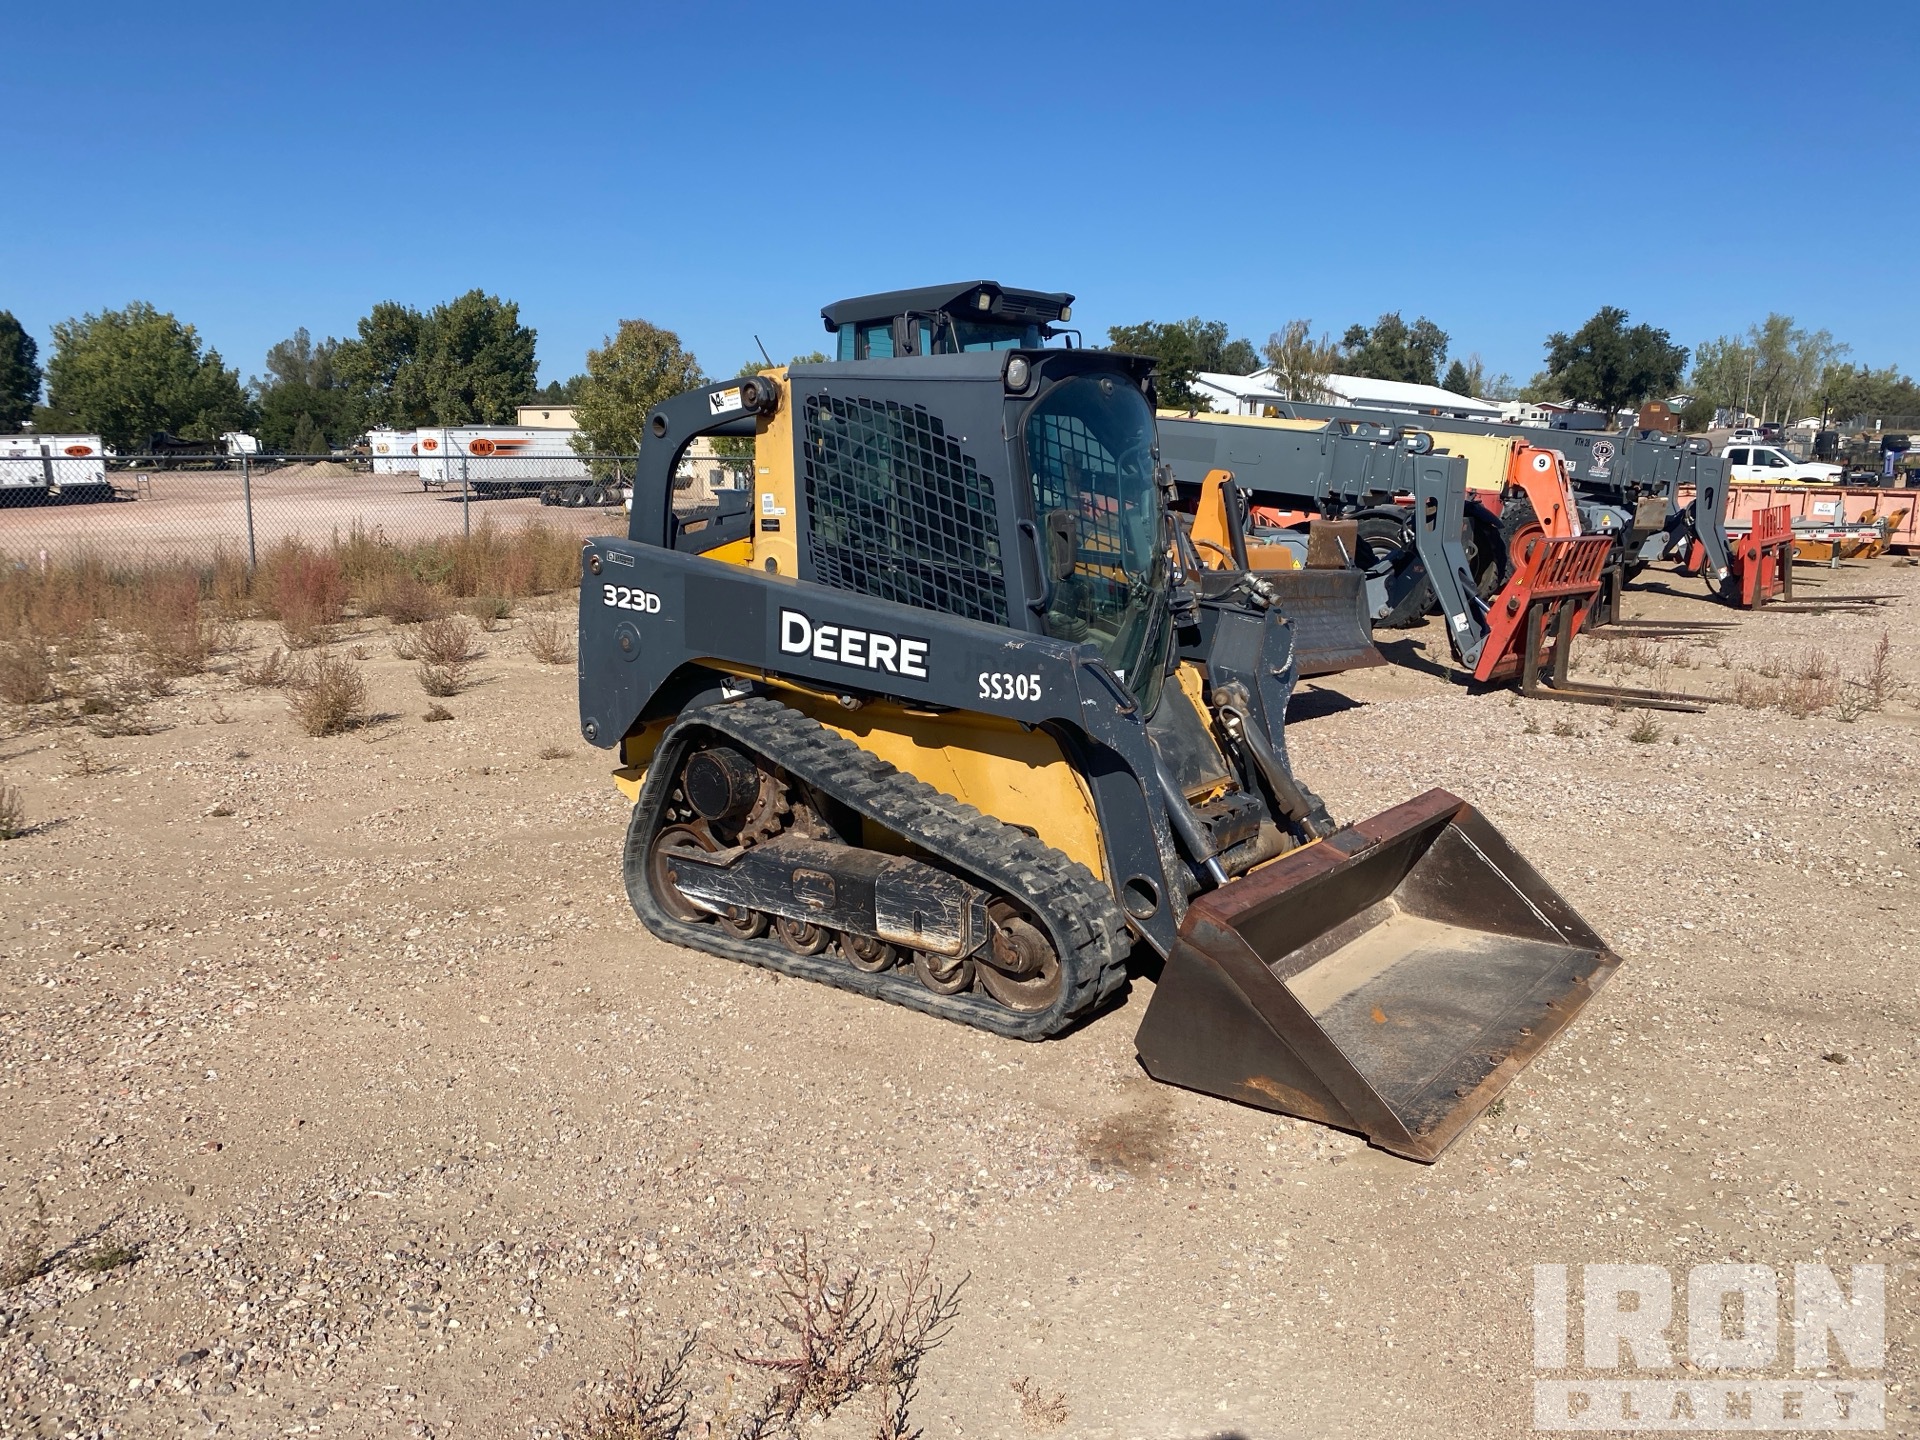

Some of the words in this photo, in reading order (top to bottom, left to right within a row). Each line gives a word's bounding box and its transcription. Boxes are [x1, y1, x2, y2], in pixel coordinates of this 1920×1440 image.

[471, 443, 493, 451] MME
[1538, 458, 1546, 468] 9
[603, 583, 661, 614] 323D
[781, 610, 928, 678] DEERE
[978, 672, 1042, 701] SS305
